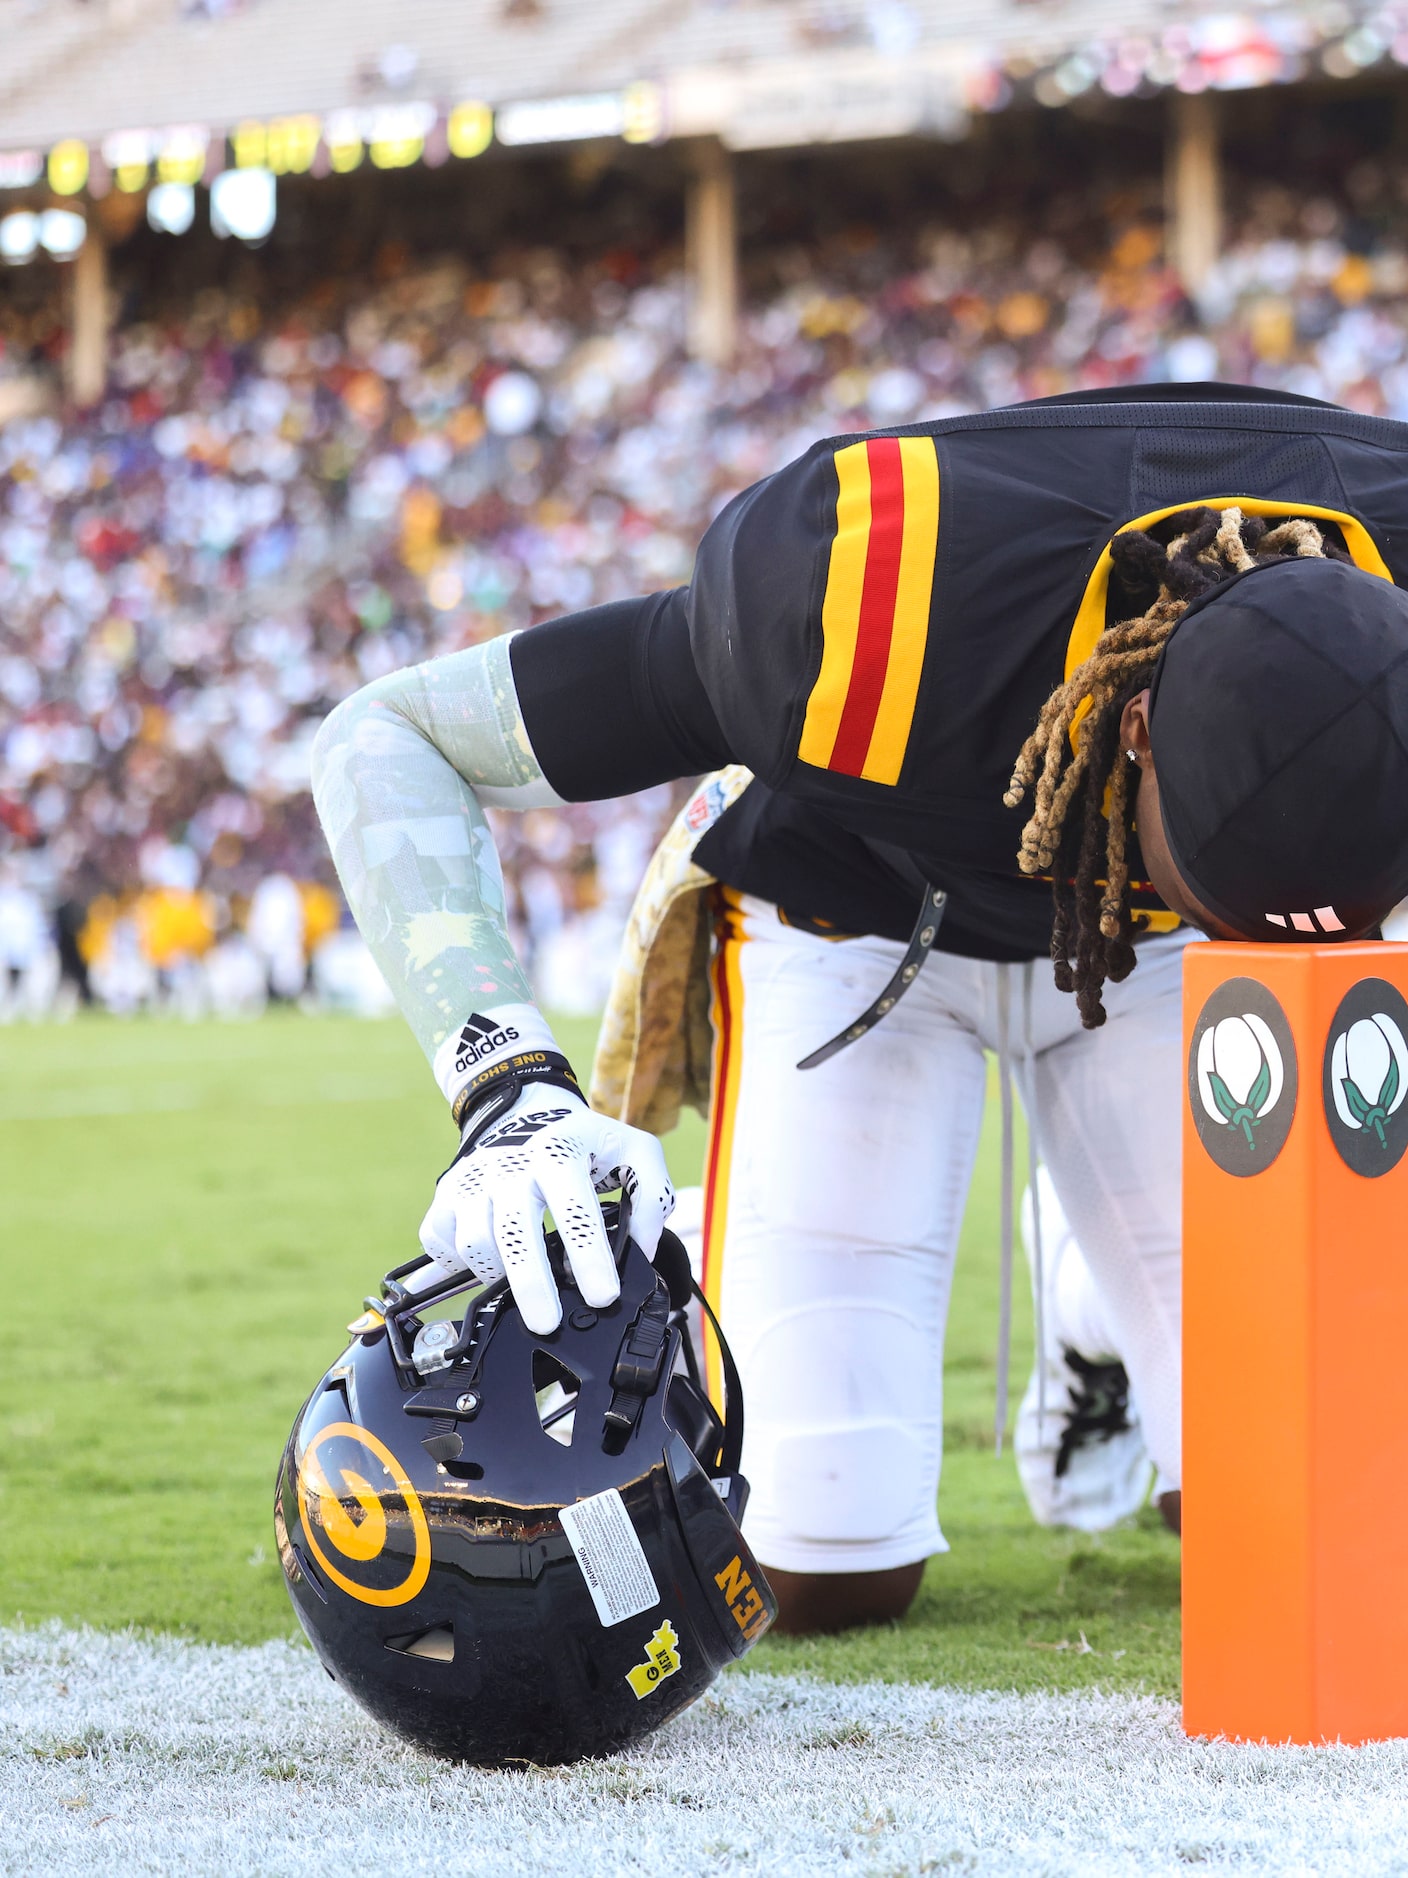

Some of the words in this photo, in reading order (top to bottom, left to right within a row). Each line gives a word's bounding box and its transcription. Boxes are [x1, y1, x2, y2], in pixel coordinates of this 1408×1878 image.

[455, 1027, 520, 1073] adidas
[514, 1053, 547, 1067] ONE
[471, 1063, 510, 1088] SHOT
[577, 1546, 598, 1588] WARNING
[655, 1649, 674, 1673] MEN
[646, 1666, 660, 1681] G
